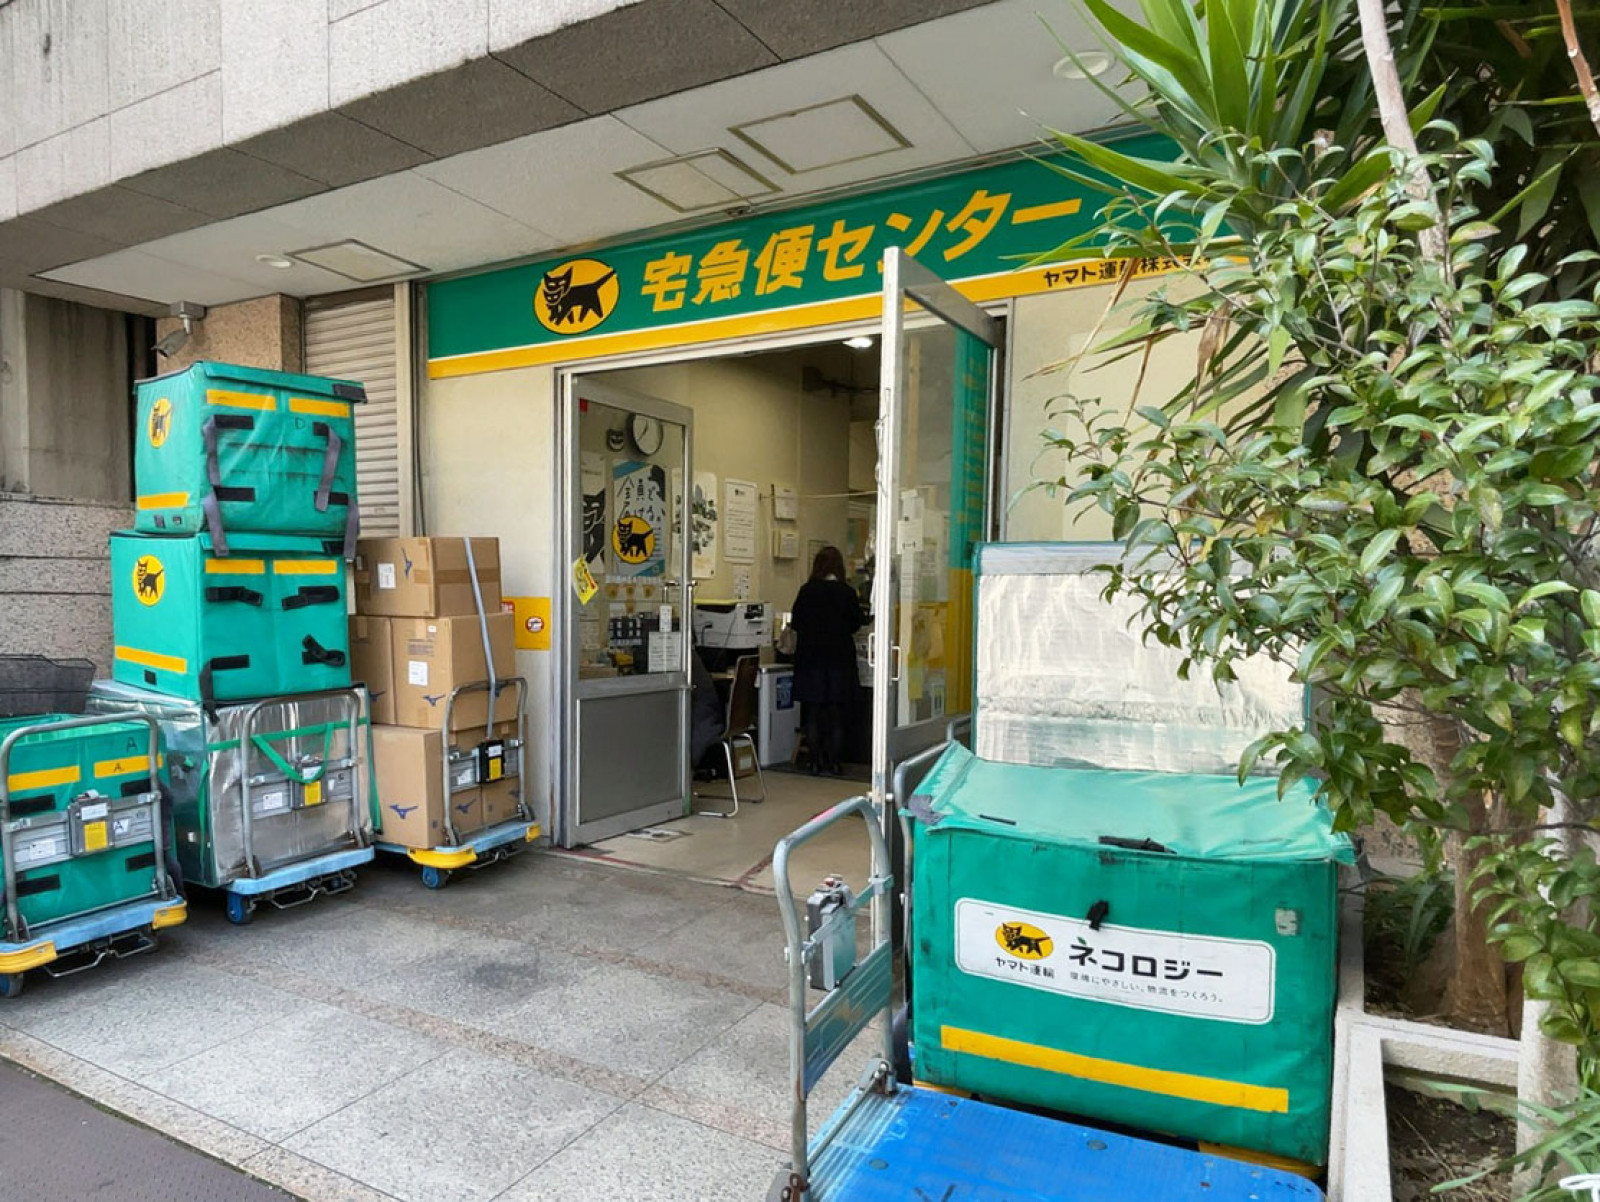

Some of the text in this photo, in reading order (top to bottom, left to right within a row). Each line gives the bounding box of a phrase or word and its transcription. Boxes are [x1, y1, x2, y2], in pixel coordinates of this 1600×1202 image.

[642, 190, 1081, 312] 宅急便センター
[126, 737, 138, 753] A
[995, 956, 1056, 979] ヤマト運輸
[1068, 937, 1224, 981] ネコロジー
